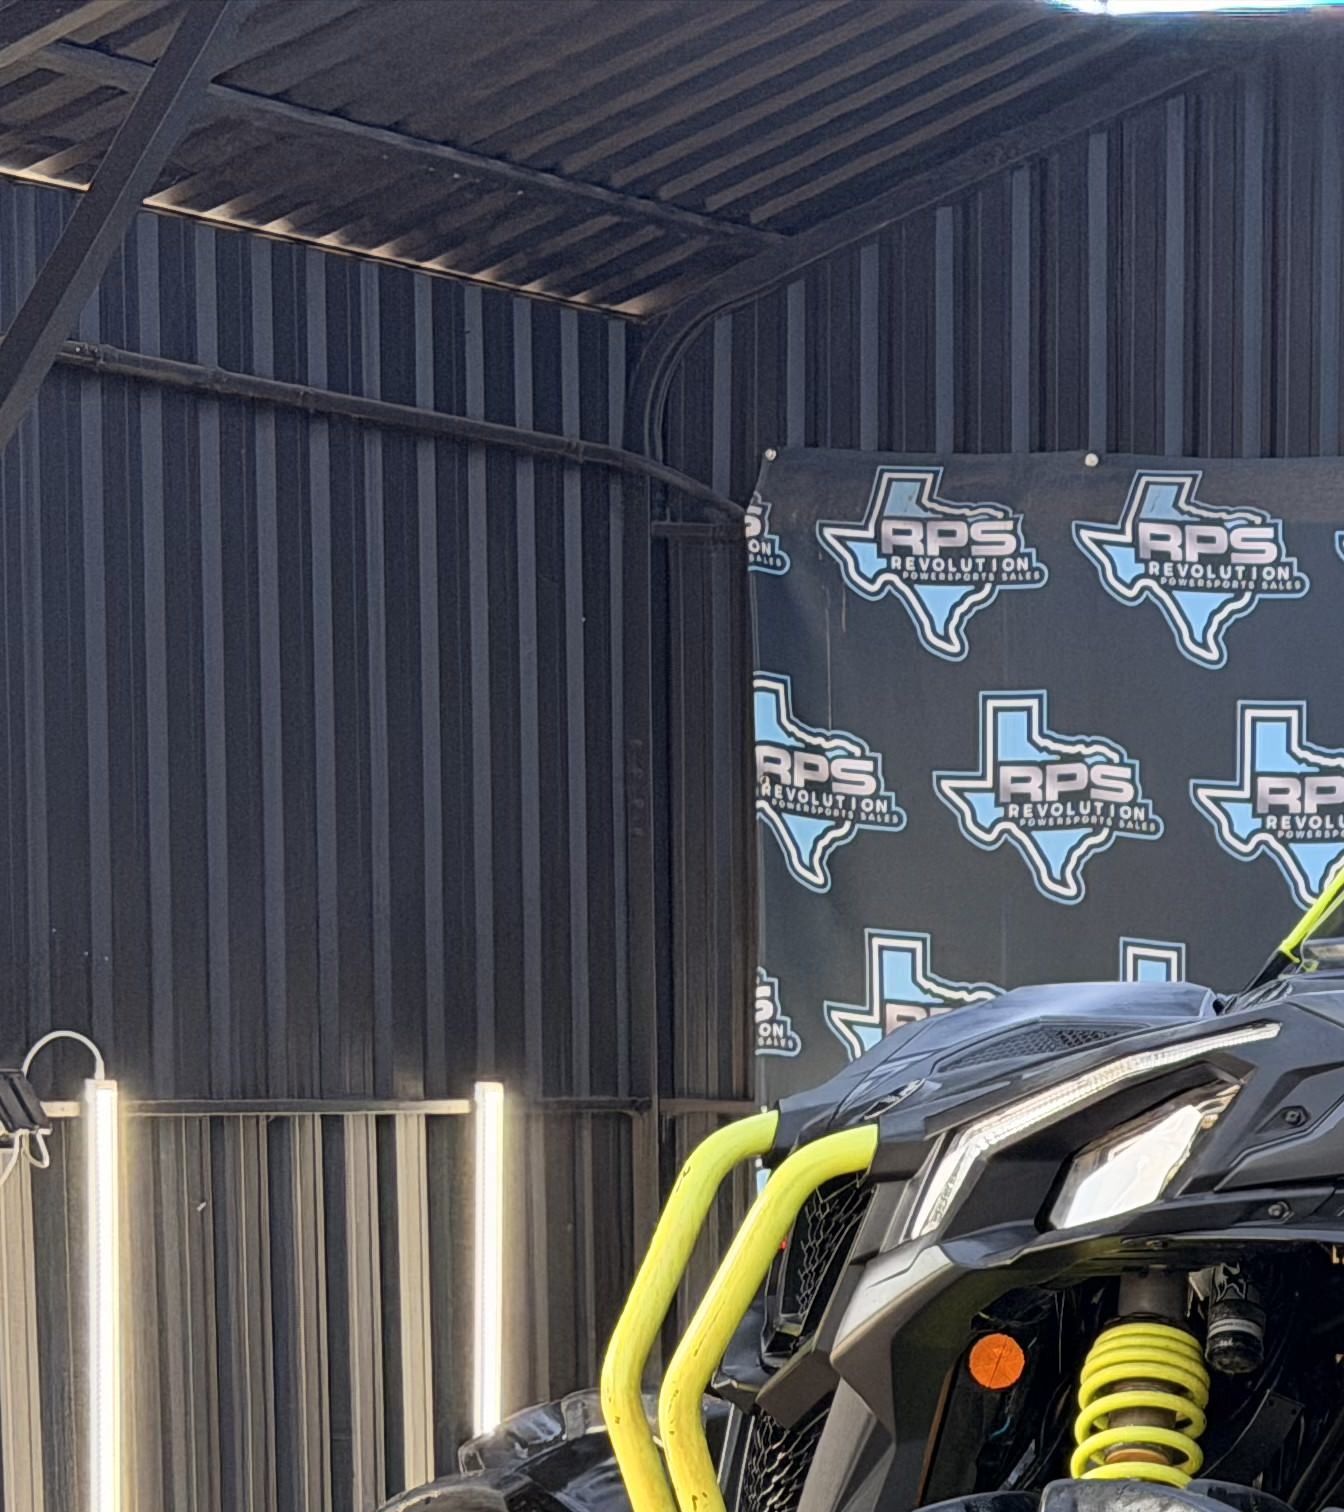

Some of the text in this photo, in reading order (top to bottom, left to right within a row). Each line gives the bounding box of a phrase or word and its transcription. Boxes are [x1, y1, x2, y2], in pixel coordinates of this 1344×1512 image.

[881, 519, 1017, 557] RPS
[1139, 522, 1278, 564] RPS
[891, 557, 1029, 572] REVOLUTION
[1149, 562, 1290, 580] REVOLUTION
[902, 570, 1041, 582] POWERSPORTS SALES
[1160, 577, 1301, 591] POWERSPORTS SALES
[756, 746, 877, 796] RPS
[999, 764, 1135, 803] RPS
[758, 784, 888, 813] REVOLUTION
[771, 799, 899, 824] POWERSPORTS SALES
[1008, 801, 1145, 821] REVOLUTION
[1019, 815, 1156, 832] POWERSPORTS SALES
